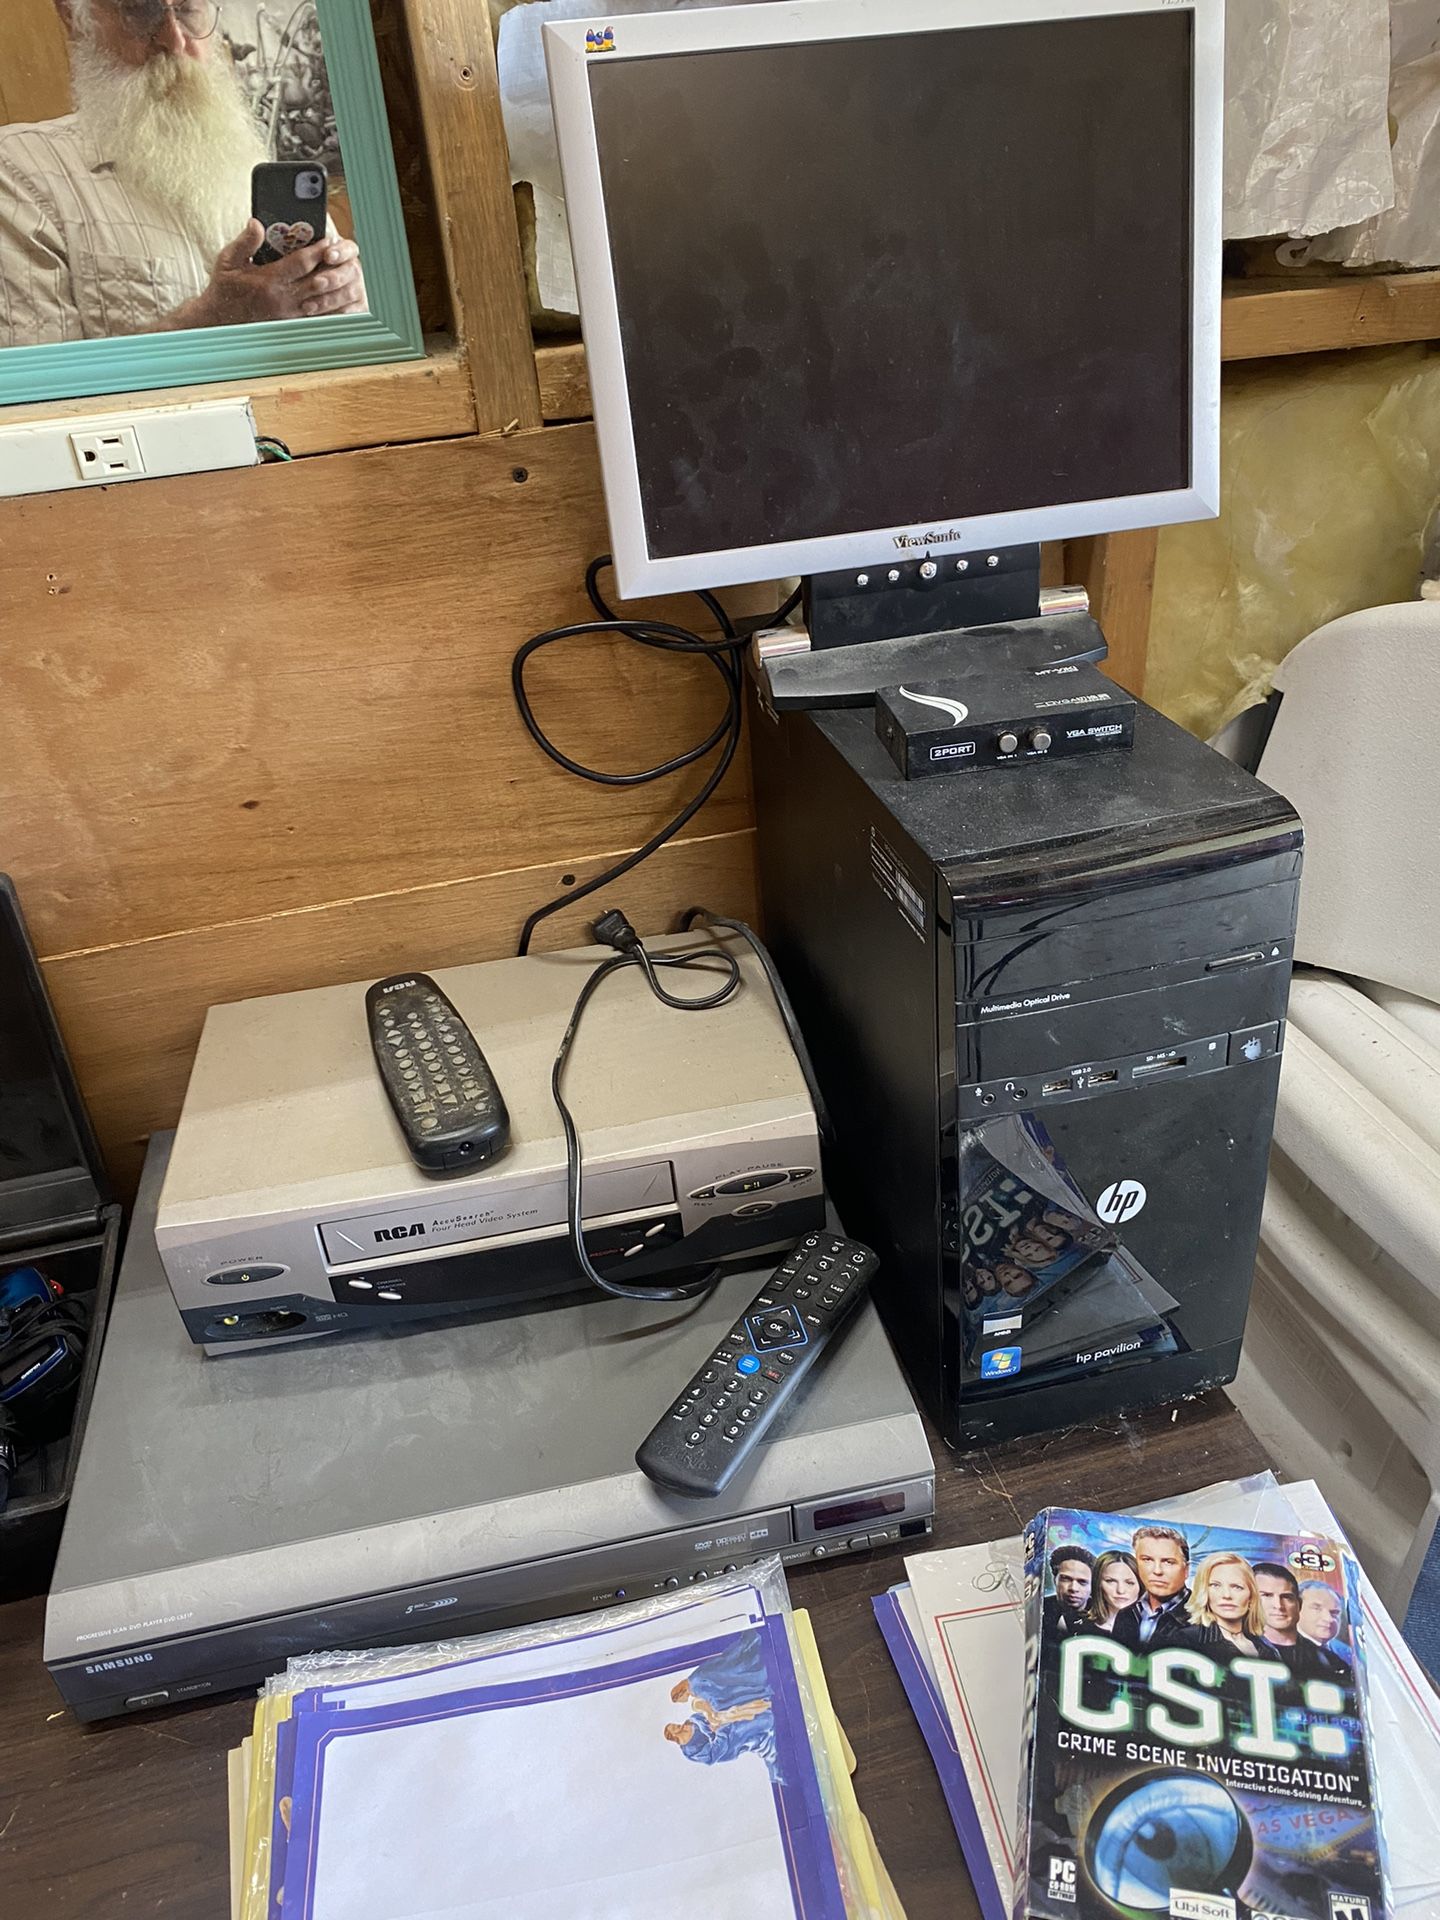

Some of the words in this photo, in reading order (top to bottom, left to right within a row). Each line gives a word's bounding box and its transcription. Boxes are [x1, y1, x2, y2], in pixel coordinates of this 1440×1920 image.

[892, 529, 961, 548] ViewSonic
[1066, 729, 1086, 738] VGA
[1088, 723, 1123, 735] SWITCH
[934, 744, 973, 757] 2PORT
[980, 1001, 1022, 1014] Multimedia
[1023, 995, 1050, 1007] Optical
[1051, 993, 1071, 1002] Drive
[1103, 1180, 1140, 1224] hp
[431, 1224, 451, 1233] Four
[454, 1219, 477, 1229] Head
[480, 1214, 504, 1225] Video
[507, 1208, 538, 1219] System
[374, 1222, 426, 1242] RCA
[220, 1255, 264, 1265] POWER
[830, 1284, 844, 1293] LAST
[807, 1315, 820, 1323] INFO
[770, 1323, 784, 1332] OK
[780, 1352, 793, 1361] EXIT
[1076, 1353, 1091, 1364] hp
[1094, 1341, 1141, 1360] pavilion
[704, 1371, 712, 1379] 1
[985, 1368, 1012, 1377] Windows
[728, 1380, 738, 1389] 2
[754, 1391, 763, 1400] 3
[716, 1398, 725, 1406] 5
[679, 1404, 688, 1413] 7
[742, 1408, 751, 1417] 6
[704, 1414, 713, 1423] 8
[691, 1431, 700, 1440] 0
[729, 1426, 738, 1435] 9
[1303, 1554, 1320, 1567] 3
[76, 1628, 112, 1641] PROGRESSIVE
[113, 1625, 128, 1635] SCAN
[129, 1623, 142, 1631] DVD
[143, 1618, 163, 1628] PLAYER
[164, 1615, 175, 1624] DVD
[85, 1653, 153, 1674] SAMSUNG
[1059, 1635, 1348, 1760] CSI:
[1058, 1731, 1117, 1757] CRIME
[1126, 1742, 1188, 1768] SCENE
[1225, 1779, 1266, 1792] Interactive
[1267, 1785, 1322, 1801] Crime-Solving
[1050, 1857, 1076, 1883] PC
[1330, 1894, 1367, 1905] MATURE
[1174, 1900, 1199, 1914] Ubi
[1201, 1905, 1230, 1919] Soft
